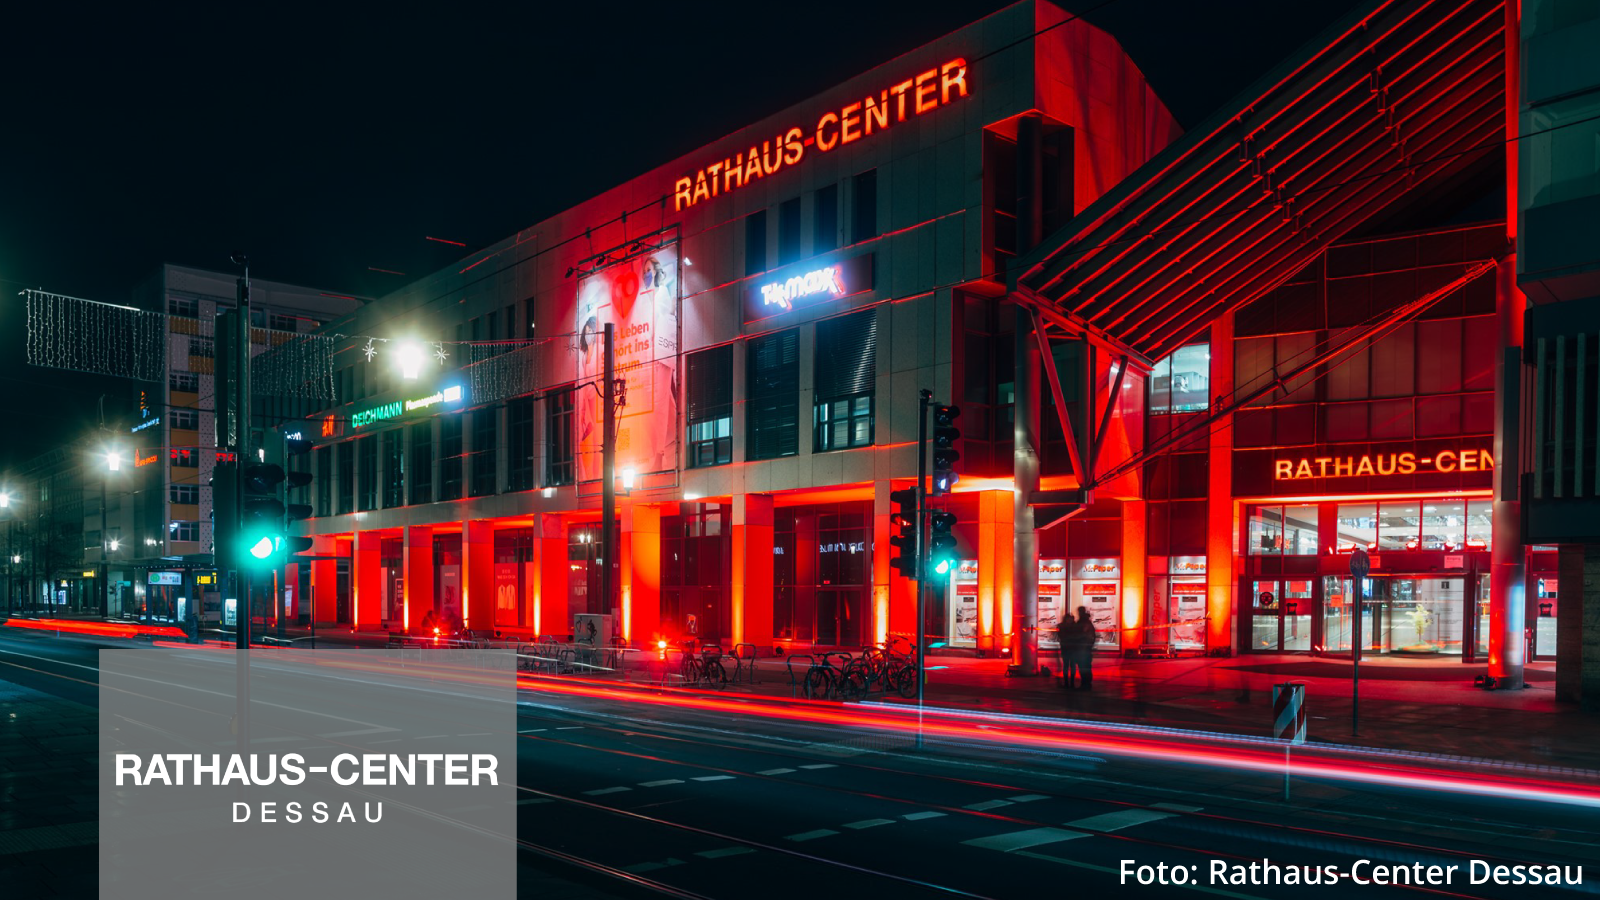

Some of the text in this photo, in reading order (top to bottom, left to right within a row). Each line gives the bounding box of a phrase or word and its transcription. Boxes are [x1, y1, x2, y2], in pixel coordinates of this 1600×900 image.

[675, 57, 970, 212] RATHAUS-CENTER
[620, 322, 649, 340] Leben
[634, 338, 650, 353] ins
[352, 401, 402, 428] DEICHMANN
[1083, 564, 1115, 573] McPaper
